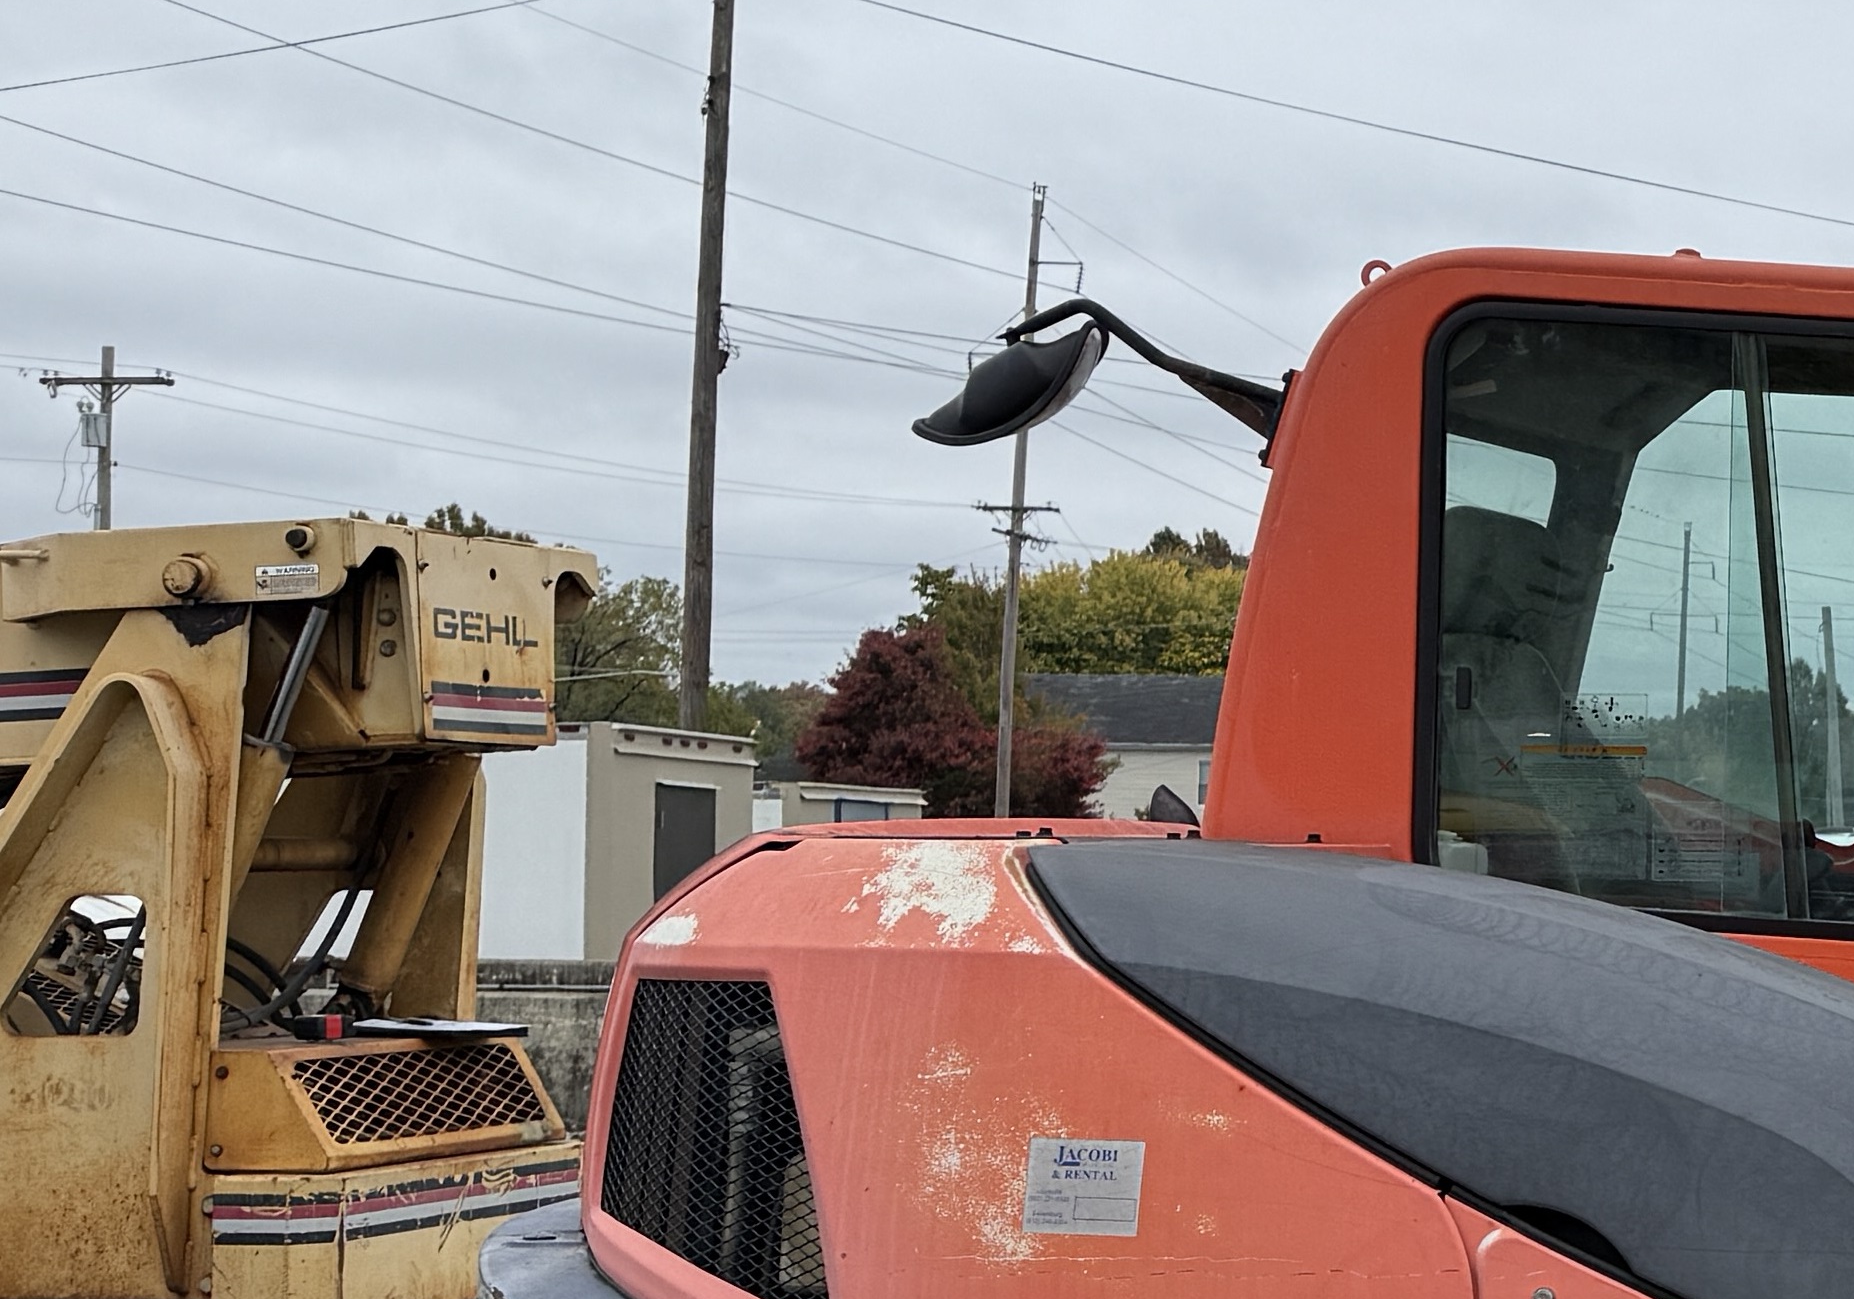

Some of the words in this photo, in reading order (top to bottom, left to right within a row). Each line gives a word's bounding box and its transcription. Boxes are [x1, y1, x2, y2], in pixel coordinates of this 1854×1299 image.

[433, 607, 539, 648] GEHL
[1053, 1145, 1118, 1167] JACOBI
[1064, 1169, 1118, 1181] RENTAL
